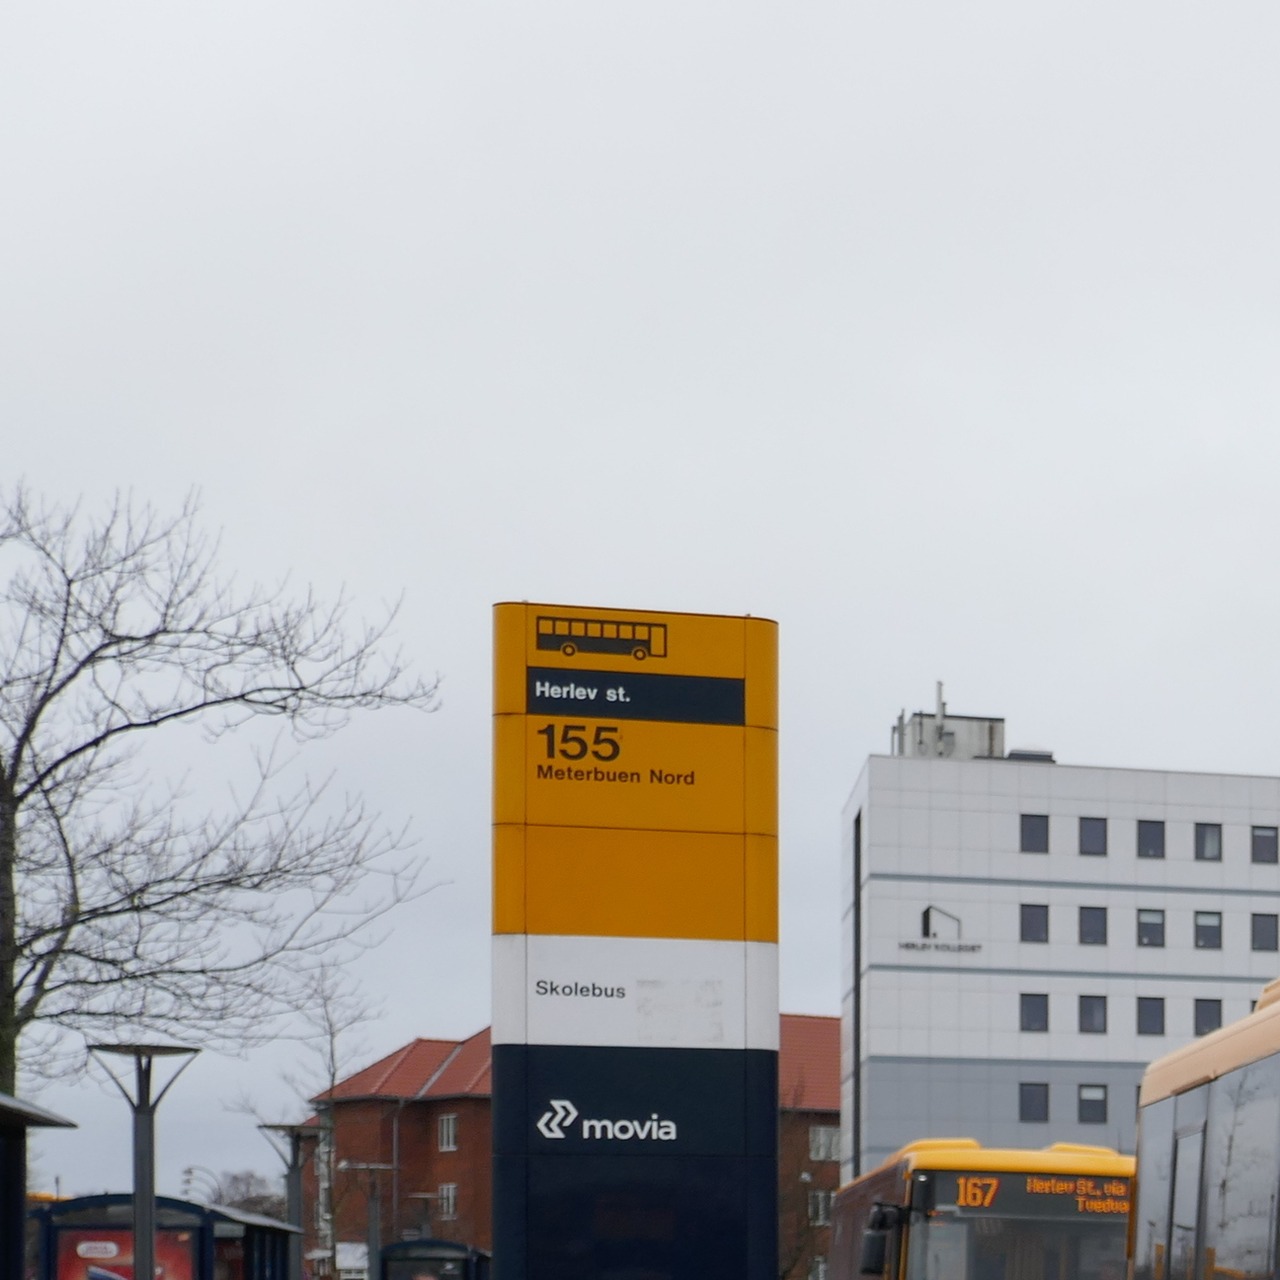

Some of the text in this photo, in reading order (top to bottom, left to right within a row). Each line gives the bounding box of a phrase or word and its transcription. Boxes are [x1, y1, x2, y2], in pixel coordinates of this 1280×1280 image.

[535, 681, 631, 702] Herlev st.
[537, 724, 621, 761] 155
[536, 765, 695, 786] Meterbuen Nord
[535, 980, 626, 999] Skolebus
[582, 1113, 677, 1141] movia
[956, 1176, 999, 1207] 167
[1026, 1176, 1074, 1194] Herlev
